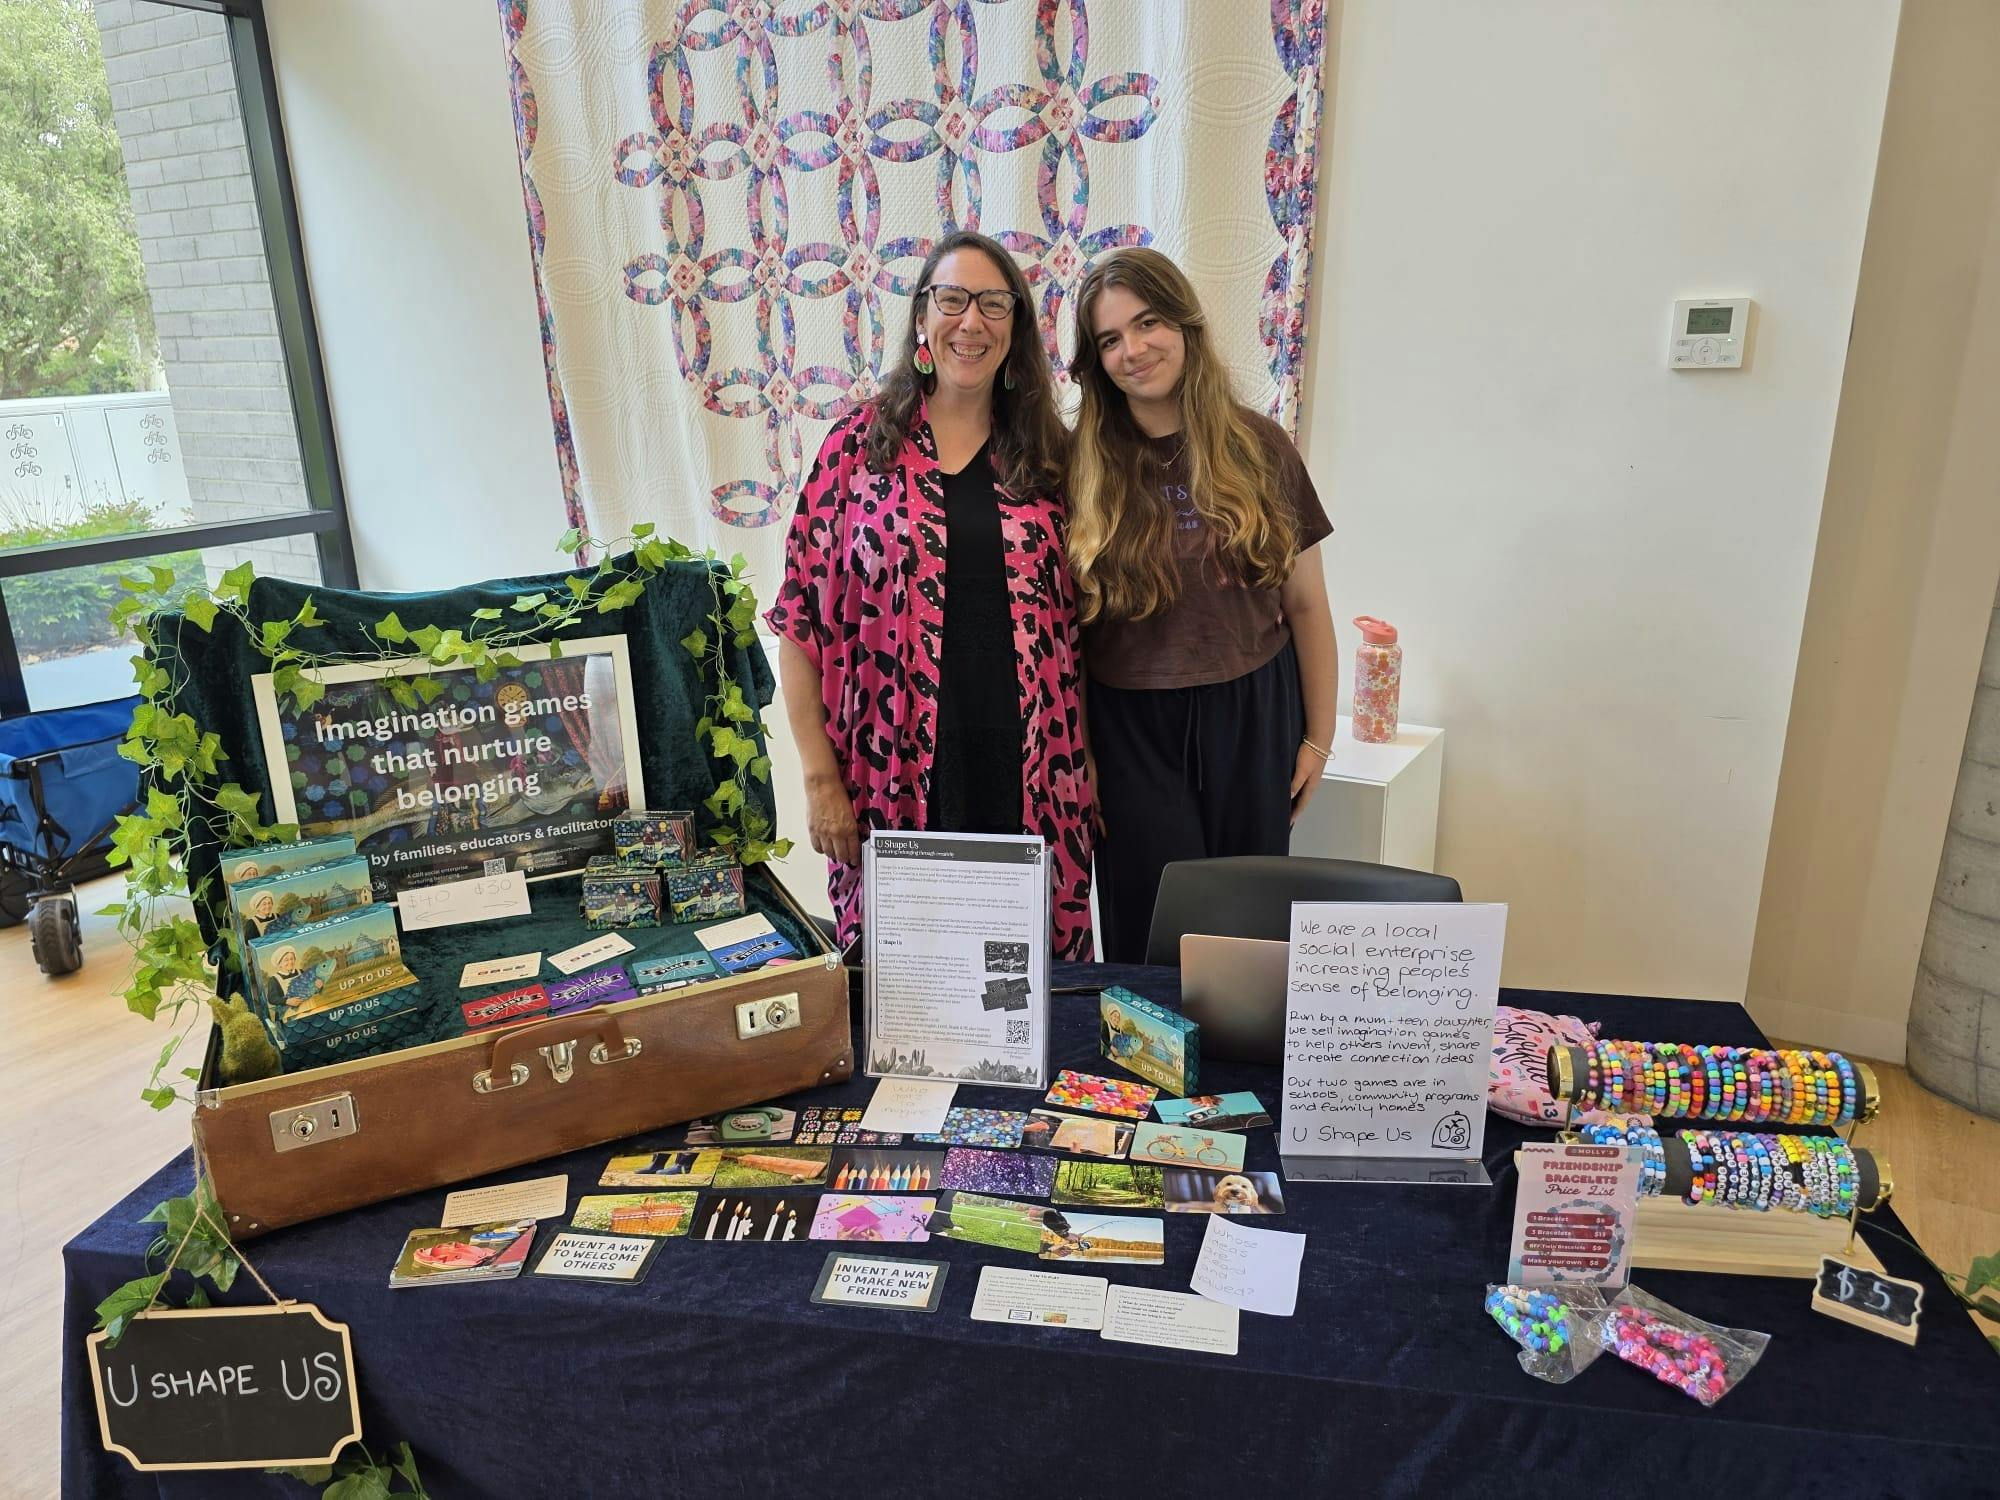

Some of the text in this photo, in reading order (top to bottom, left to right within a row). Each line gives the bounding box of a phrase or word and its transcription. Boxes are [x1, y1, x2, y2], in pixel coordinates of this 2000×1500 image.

[315, 690, 593, 743] Imagination games
[372, 735, 552, 775] that nurture
[396, 773, 542, 810] belonging
[371, 853, 391, 868] by
[393, 843, 457, 863] families,
[460, 830, 532, 853] educators
[534, 826, 545, 840] &
[876, 839, 920, 850] U Shape Us
[441, 865, 470, 874] enterprise
[474, 879, 512, 896] $30
[408, 889, 450, 909] $40
[1300, 920, 1437, 937] We are a local
[1298, 943, 1475, 962] social enterprise
[339, 966, 393, 990] UP TO US
[1296, 962, 1390, 985] increasing
[1351, 980, 1370, 1001] of
[329, 998, 380, 1020] UP TO US
[1290, 1011, 1314, 1021] Run
[1320, 1012, 1334, 1028] by
[1398, 1017, 1429, 1026] teen
[1434, 1015, 1491, 1033] daughter,
[326, 1025, 378, 1048] UP TO US
[1312, 1025, 1333, 1035] sell
[1337, 1025, 1417, 1040] imagination
[1422, 1030, 1470, 1044] games
[1288, 1039, 1480, 1054] to help others invent, share
[1298, 1052, 1342, 1062] create
[1350, 1053, 1429, 1065] connection
[1435, 1052, 1474, 1064] ideas
[1141, 1061, 1176, 1087] UP TO US
[1288, 1076, 1446, 1092] Our two games are in
[1289, 1090, 1479, 1104] schools, community programs
[1290, 1102, 1426, 1118] and family homes
[1542, 1101, 1560, 1120] 13
[1292, 1125, 1412, 1146] U Shape Us
[1543, 1161, 1623, 1172] FRIENDSHIP
[1545, 1174, 1619, 1185] BRACELETS
[1545, 1183, 1616, 1196] Price List
[556, 1240, 648, 1252] INVENT A WAY
[1213, 1227, 1258, 1248] Whose
[553, 1249, 640, 1262] TO WELCOME
[1203, 1246, 1230, 1261] are
[563, 1260, 616, 1270] OTHERS
[1203, 1256, 1246, 1275] heard
[1527, 1258, 1547, 1266] Make
[1547, 1259, 1566, 1267] your
[837, 1264, 888, 1276] INVENT
[904, 1270, 933, 1280] WAY
[1201, 1264, 1228, 1280] and
[834, 1274, 930, 1290] TO MAKE NEW
[847, 1286, 908, 1299] FRIENDS
[107, 1352, 341, 1407] U SHAPE US
